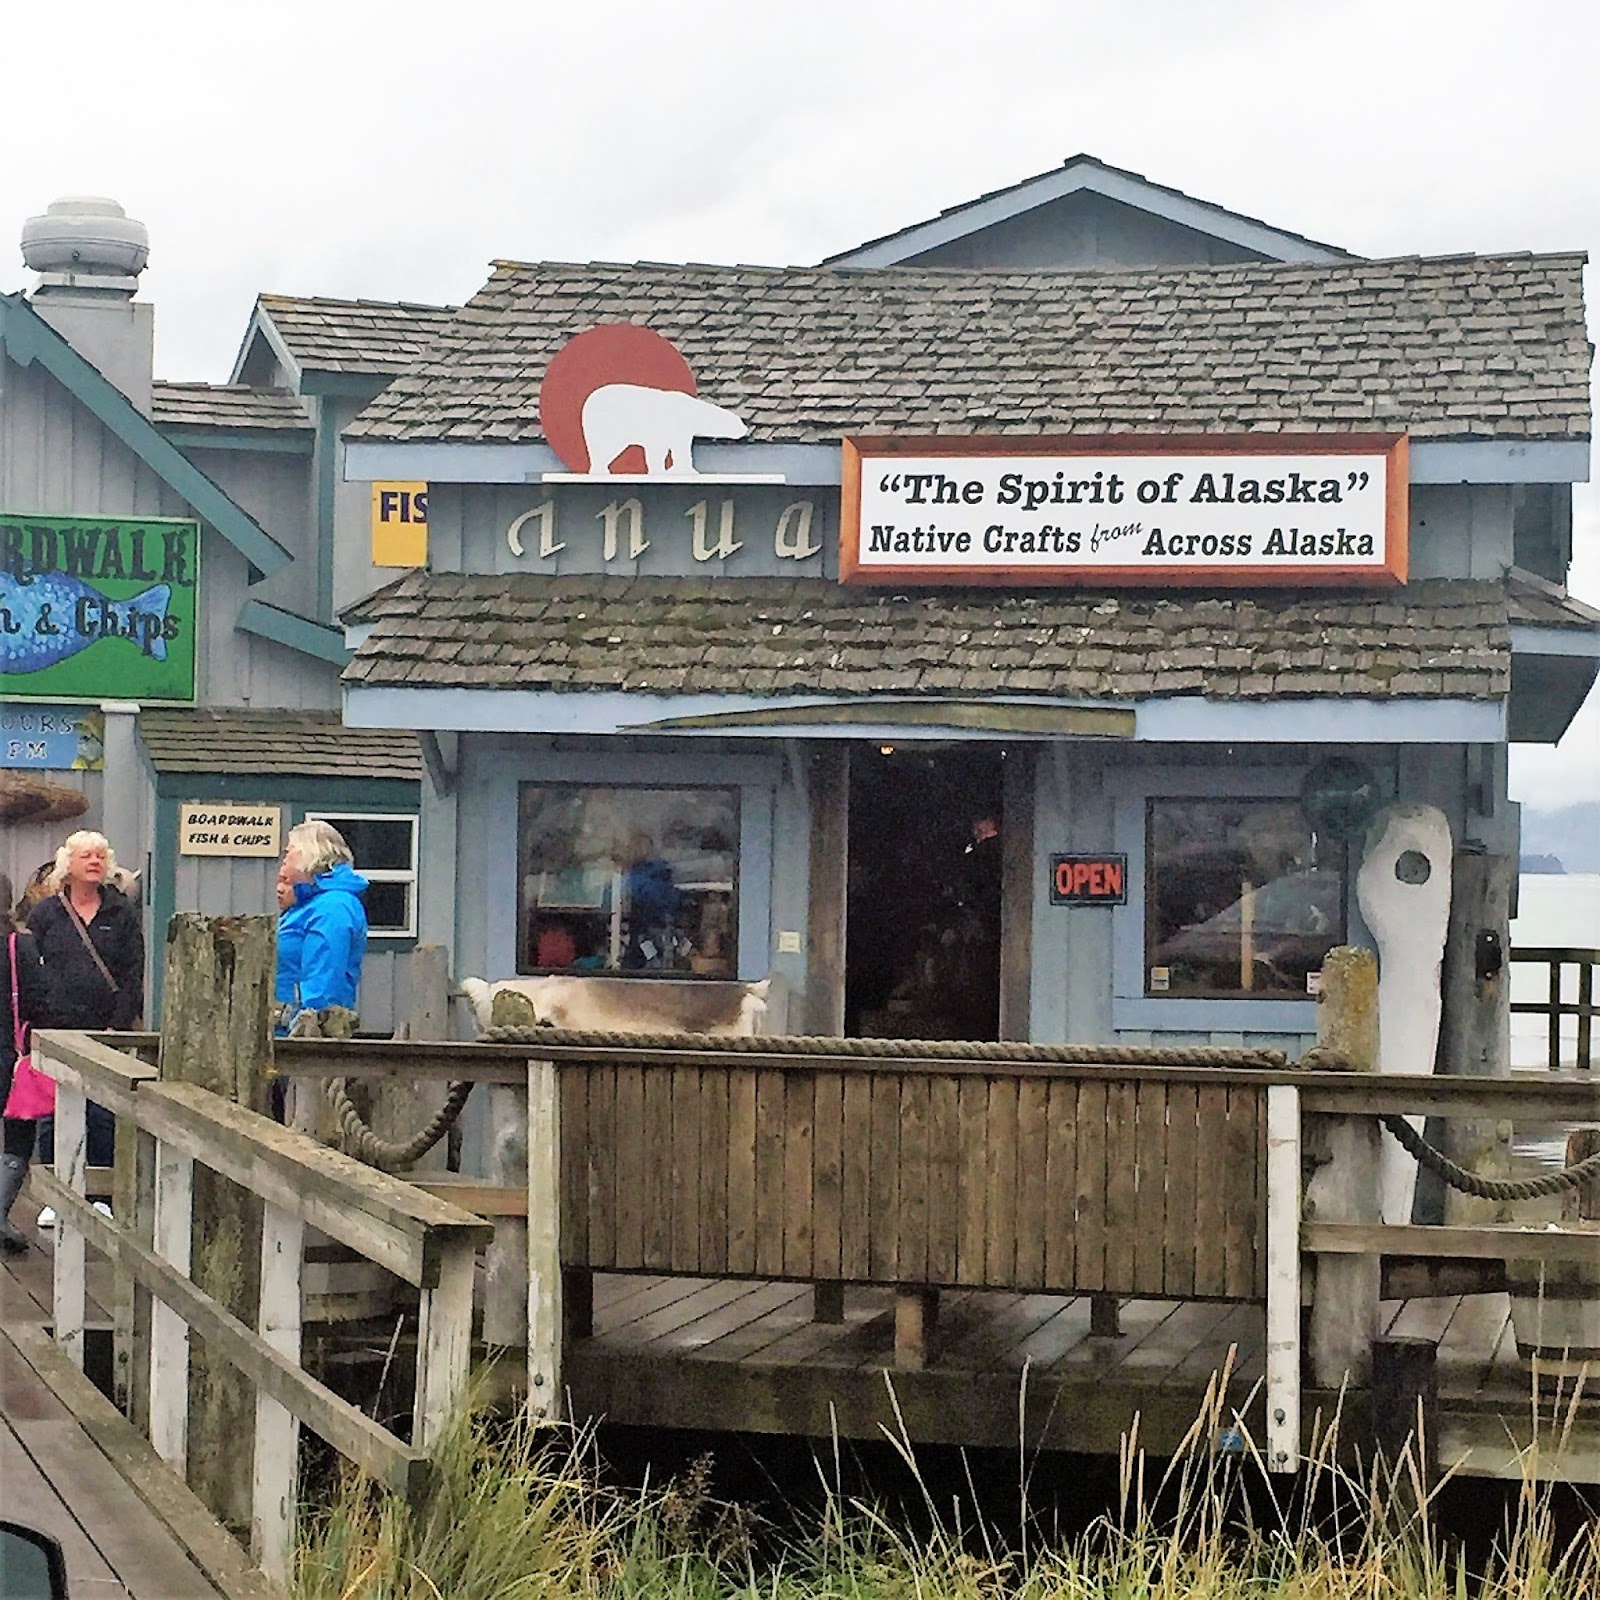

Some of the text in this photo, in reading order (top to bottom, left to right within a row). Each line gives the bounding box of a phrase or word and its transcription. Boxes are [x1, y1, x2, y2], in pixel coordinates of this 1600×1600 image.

[380, 491, 428, 523] FIS
[879, 471, 1370, 512] “The Spirit of Alaska”
[507, 497, 822, 561] anua
[868, 520, 1375, 557] Native Crafts from Across Alaska
[35, 603, 60, 635] &
[75, 596, 181, 657] Chips
[188, 814, 274, 826] BOARDWALK
[189, 833, 272, 845] FISH & CHIPS
[1056, 862, 1122, 895] OPEN
